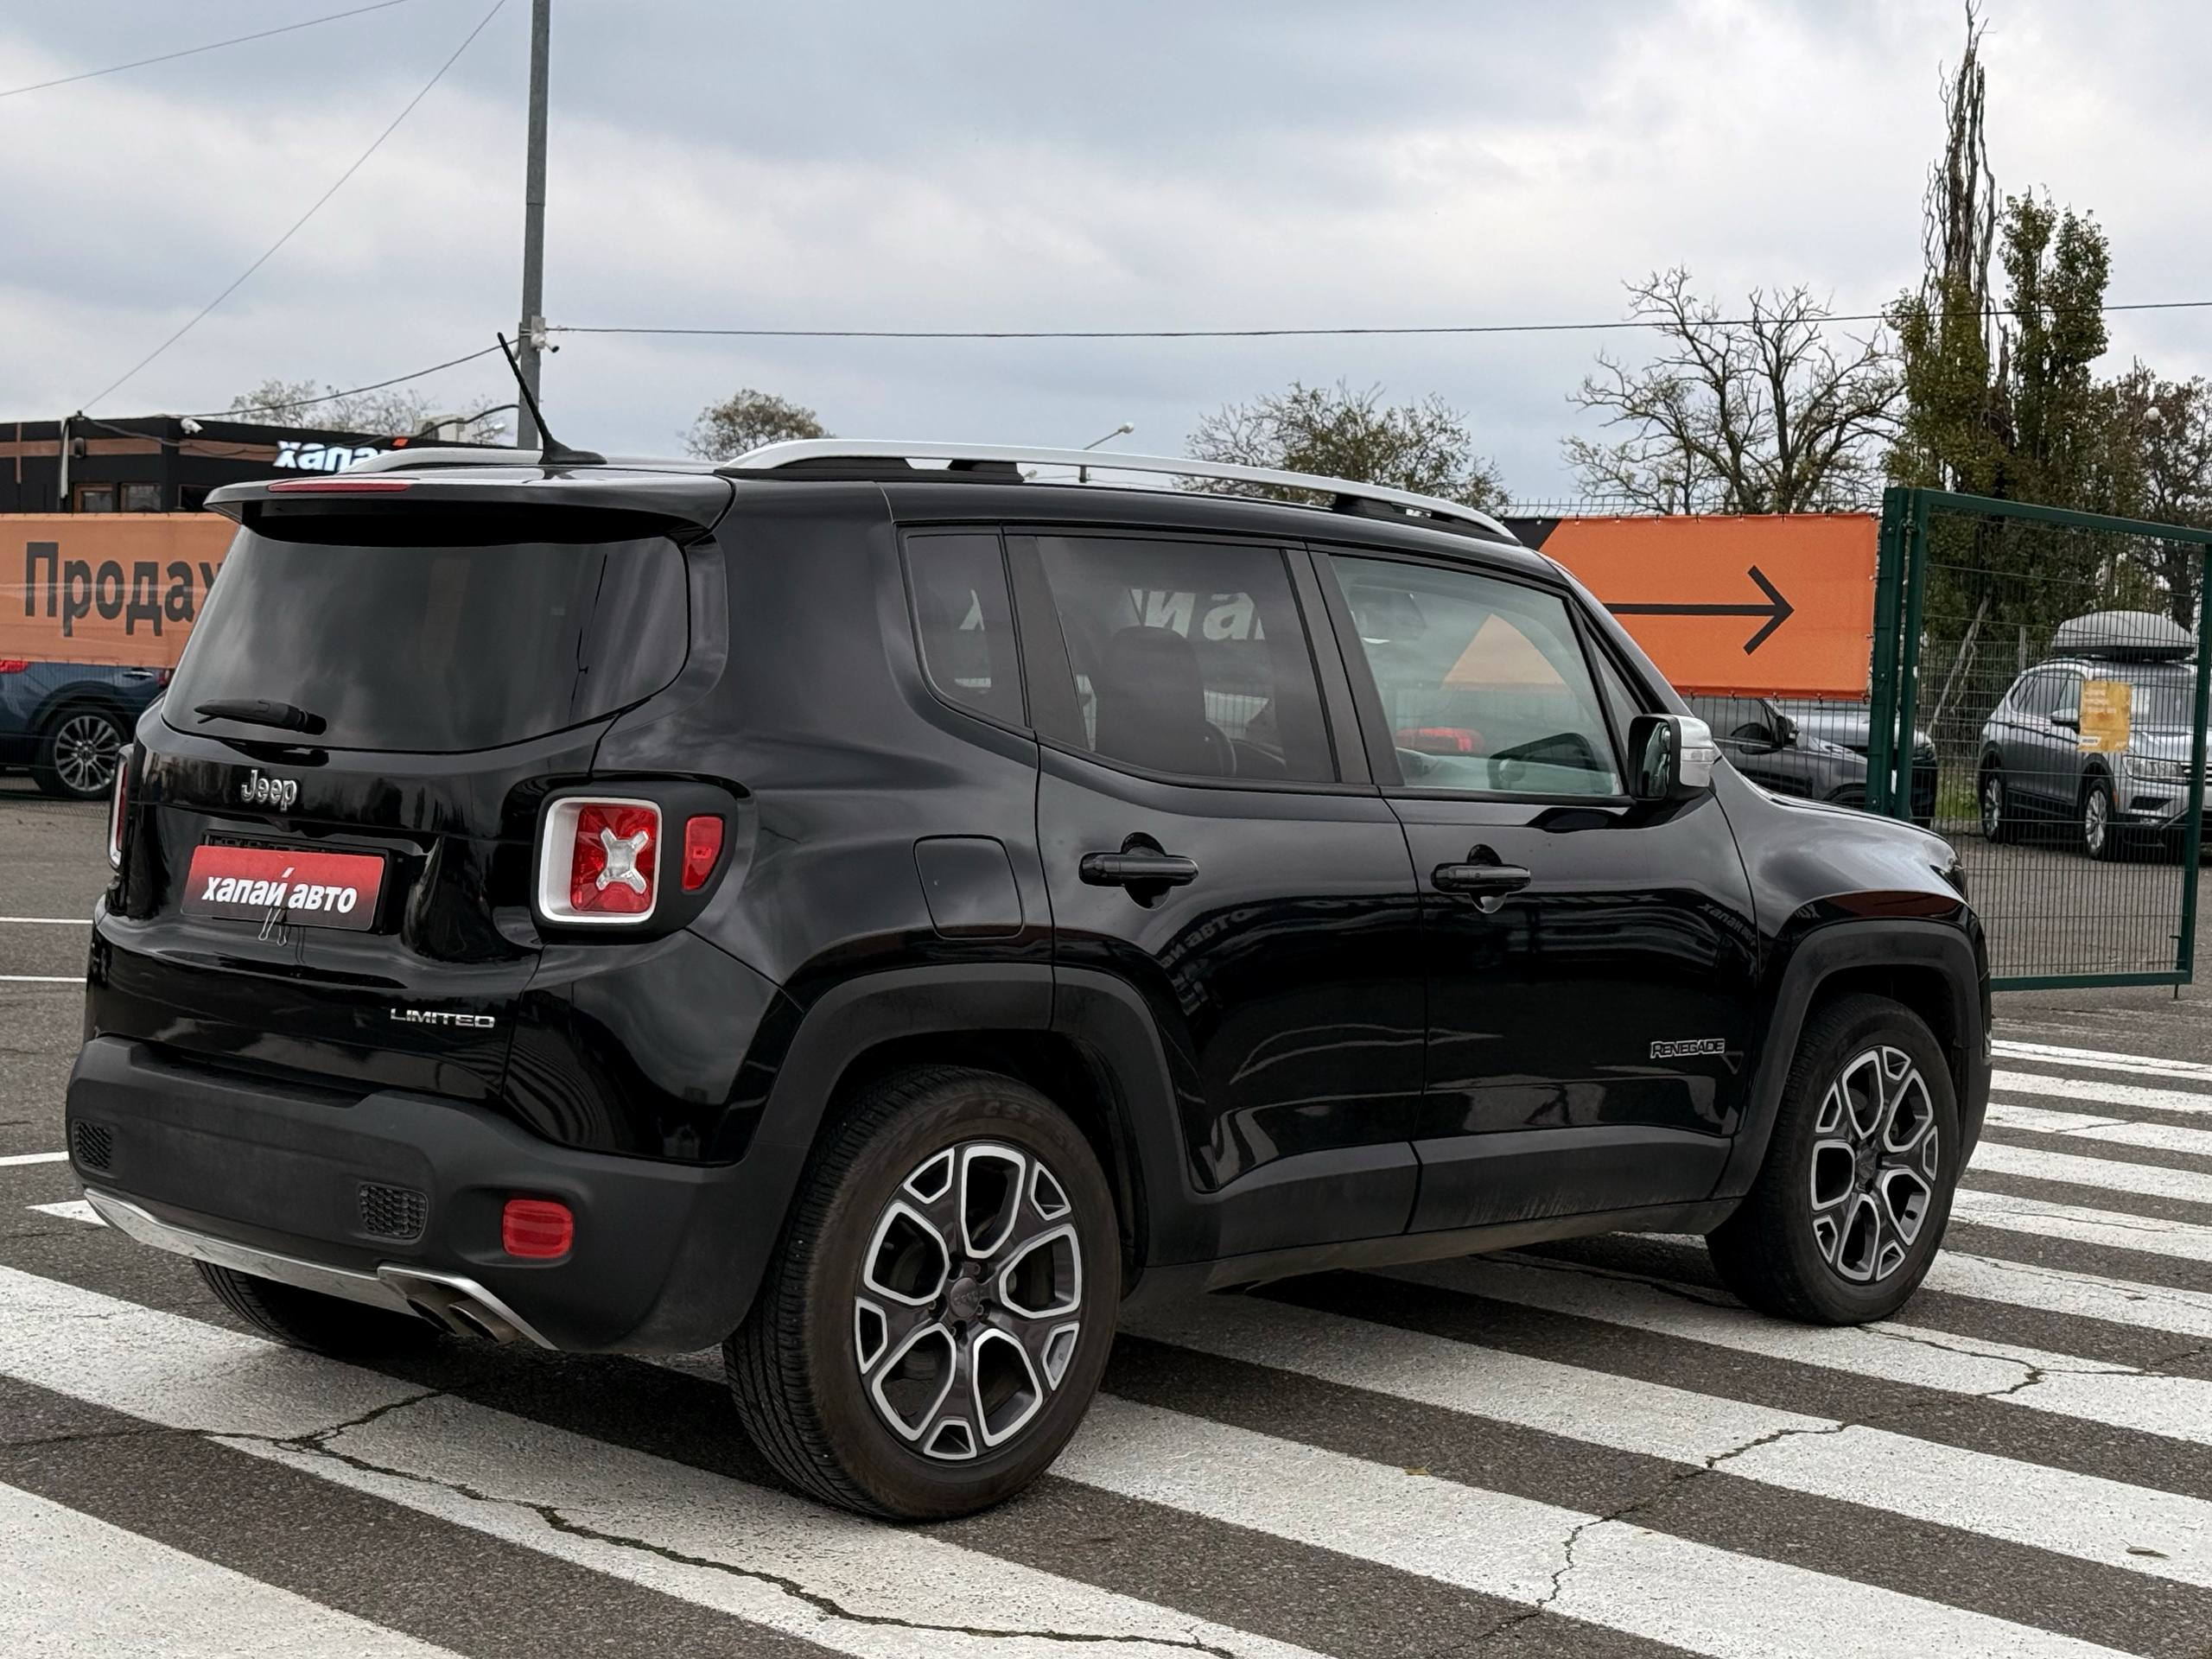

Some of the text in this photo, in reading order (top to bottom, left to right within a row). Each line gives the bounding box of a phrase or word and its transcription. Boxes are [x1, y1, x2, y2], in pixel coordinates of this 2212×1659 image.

[241, 769, 297, 812] Jeep
[288, 883, 358, 914] авто
[390, 1007, 496, 1028] LIMITED
[1649, 1038, 1726, 1059] RENEGADE
